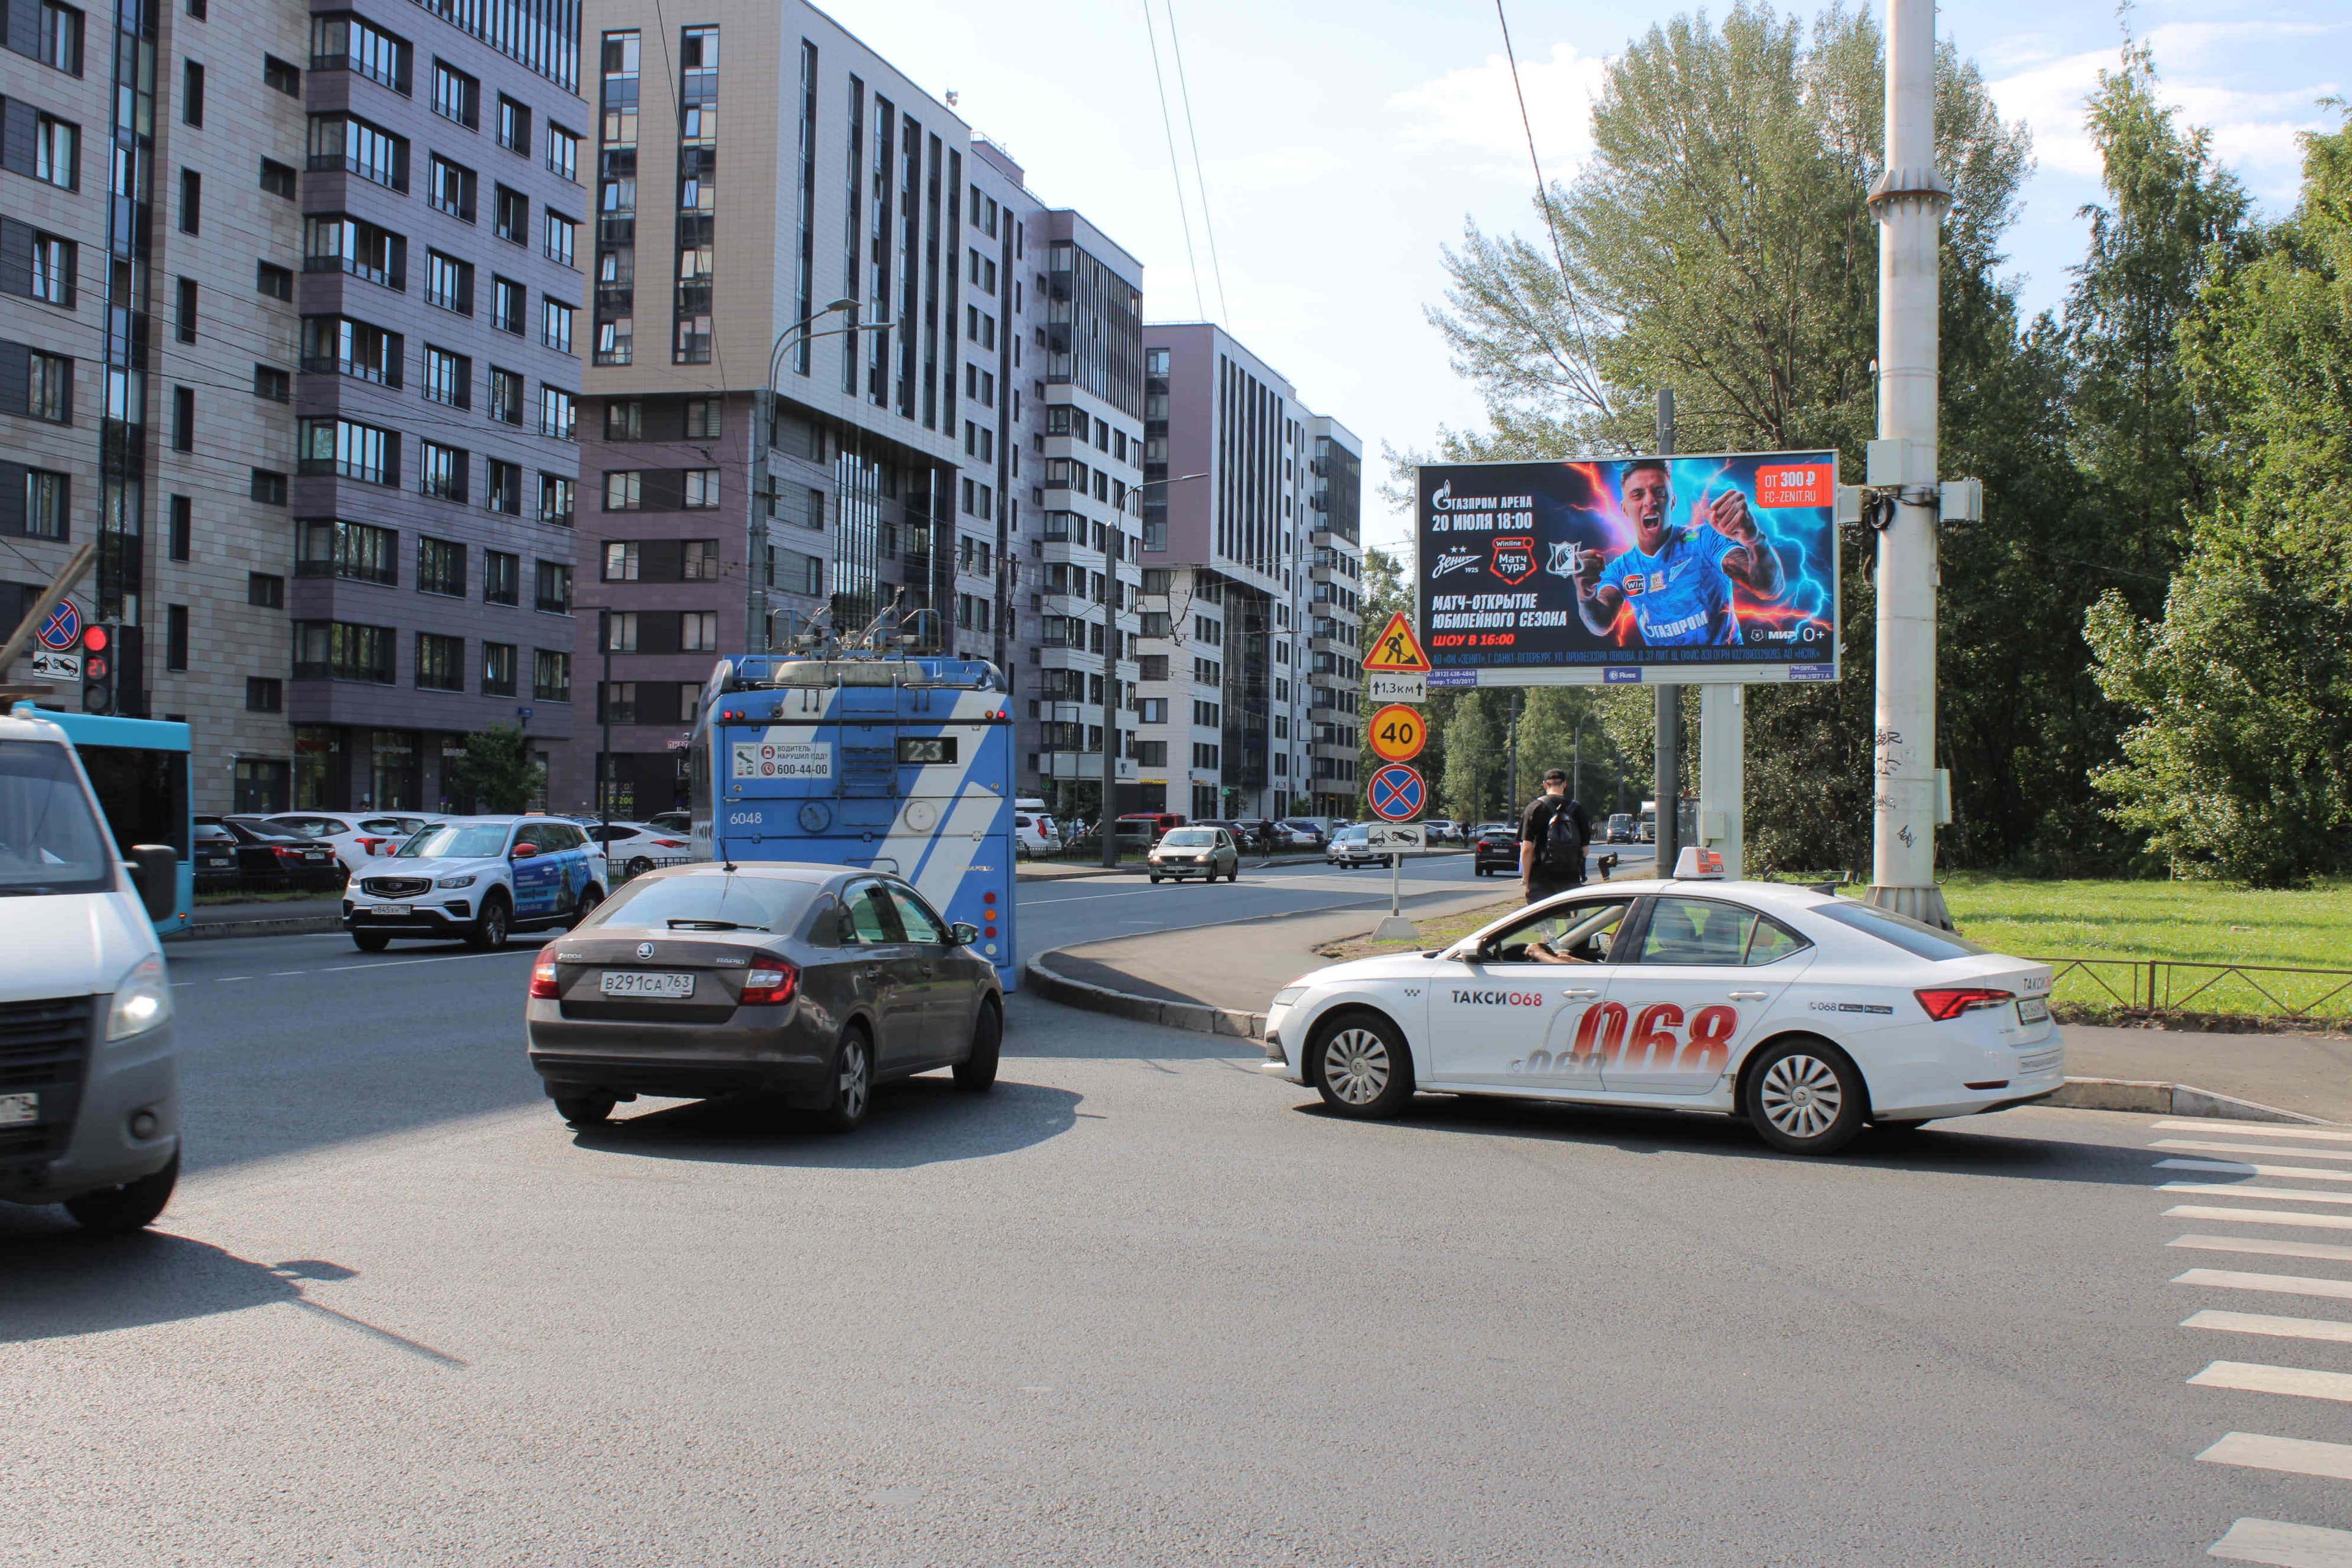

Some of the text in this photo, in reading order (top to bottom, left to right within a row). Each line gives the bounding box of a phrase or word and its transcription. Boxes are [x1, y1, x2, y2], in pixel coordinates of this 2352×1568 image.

[1765, 475, 1778, 488] ОТ
[1781, 471, 1804, 487] 300
[1451, 496, 1532, 510] ГАЗПРОМ АРЕНА
[1765, 490, 1816, 503] FC-ZENIT.RU
[1432, 511, 1532, 532] 20 ИЮЛЯ 18:00
[1499, 554, 1527, 564] Матч
[1501, 564, 1526, 573] тура
[1432, 593, 1538, 611] МАТЧ-ОТКРЫТИЕ
[1432, 610, 1567, 629] ЮБИЛЕЙНОГО СЕЗОНА
[1653, 609, 1709, 638] ГАЗПРОМ
[1433, 633, 1515, 647] ШОУ В 16:00
[1768, 631, 1797, 639] МИР
[1803, 627, 1825, 642] 0+
[1381, 722, 1413, 744] 40
[908, 741, 942, 761] 23
[777, 764, 827, 775] 600-44-00
[730, 812, 763, 824] 6048
[666, 975, 690, 988] 763
[1817, 1001, 1837, 1011] 068
[1572, 1000, 1740, 1074] 068
